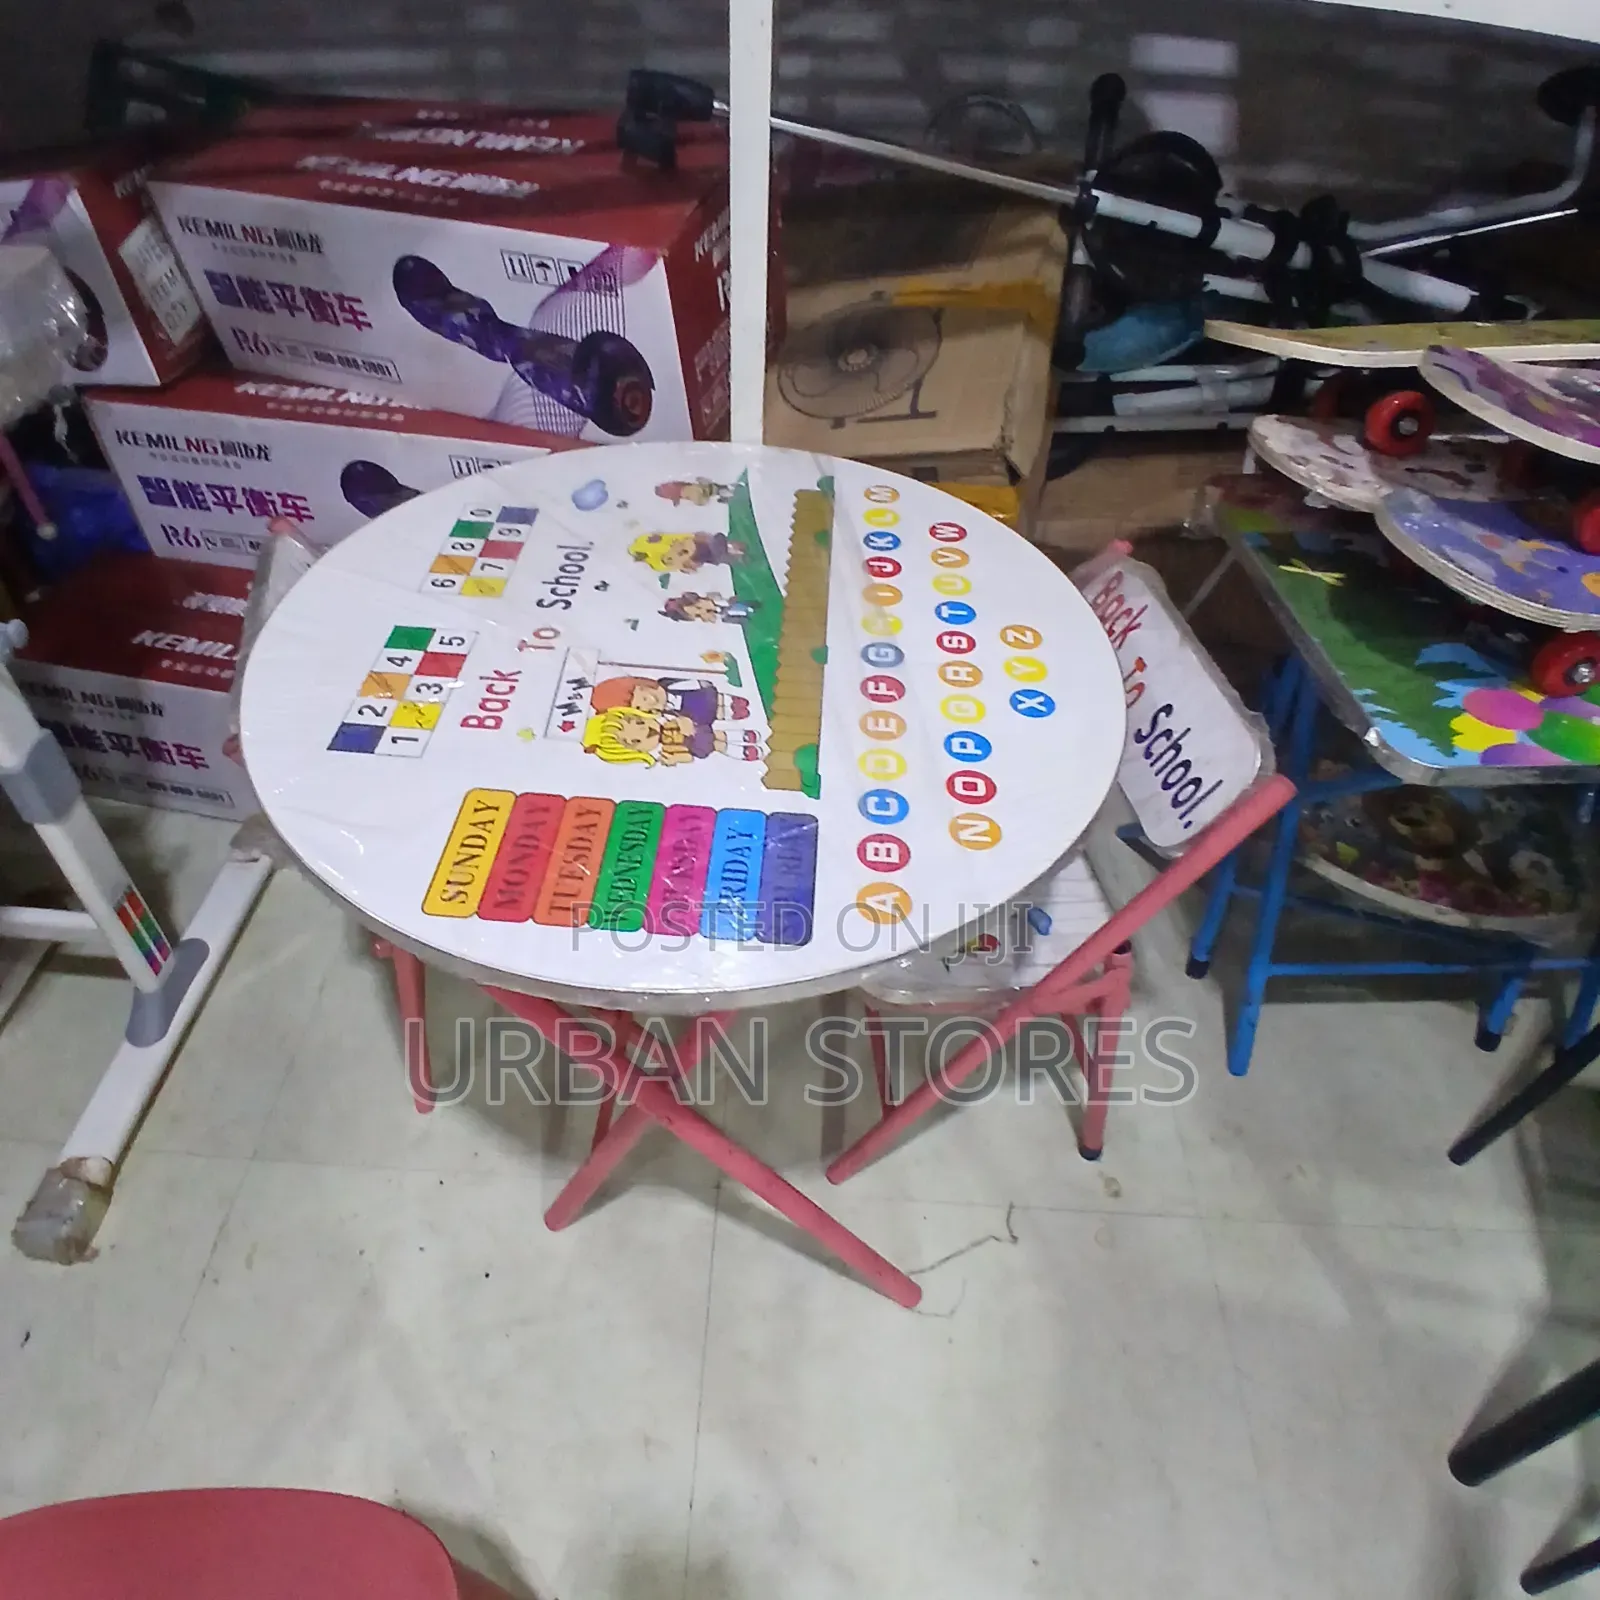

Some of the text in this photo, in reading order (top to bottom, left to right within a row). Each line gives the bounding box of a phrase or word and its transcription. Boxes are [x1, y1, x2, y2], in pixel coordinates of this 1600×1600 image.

[869, 513, 892, 522] L
[869, 535, 893, 548] K
[935, 525, 960, 539] W
[430, 508, 522, 589] 6 7 8 9 0
[937, 551, 962, 564] V
[869, 561, 894, 572] J
[940, 577, 965, 592] U
[941, 605, 968, 618] T
[131, 629, 240, 661] KEMIL
[460, 541, 595, 730] Back To School.
[943, 636, 968, 649] S
[868, 647, 896, 662] G
[1007, 630, 1047, 713] X Y Z
[357, 635, 466, 744] 1 2 3 4 5
[868, 680, 899, 700] F
[867, 717, 897, 734] E
[952, 737, 983, 755] P
[866, 757, 897, 773] D
[1134, 703, 1223, 829] School.
[954, 776, 987, 796] O
[867, 796, 898, 816] C
[955, 818, 992, 843] N
[440, 799, 500, 905] SUNDAY
[493, 801, 551, 911] MONDAY
[549, 805, 602, 916] TUESDAY
[866, 841, 899, 864] B
[603, 806, 654, 924] WEDNESDAY
[659, 812, 703, 922] HRSDAY
[717, 827, 754, 916] FRIDAY
[866, 891, 900, 917] A
